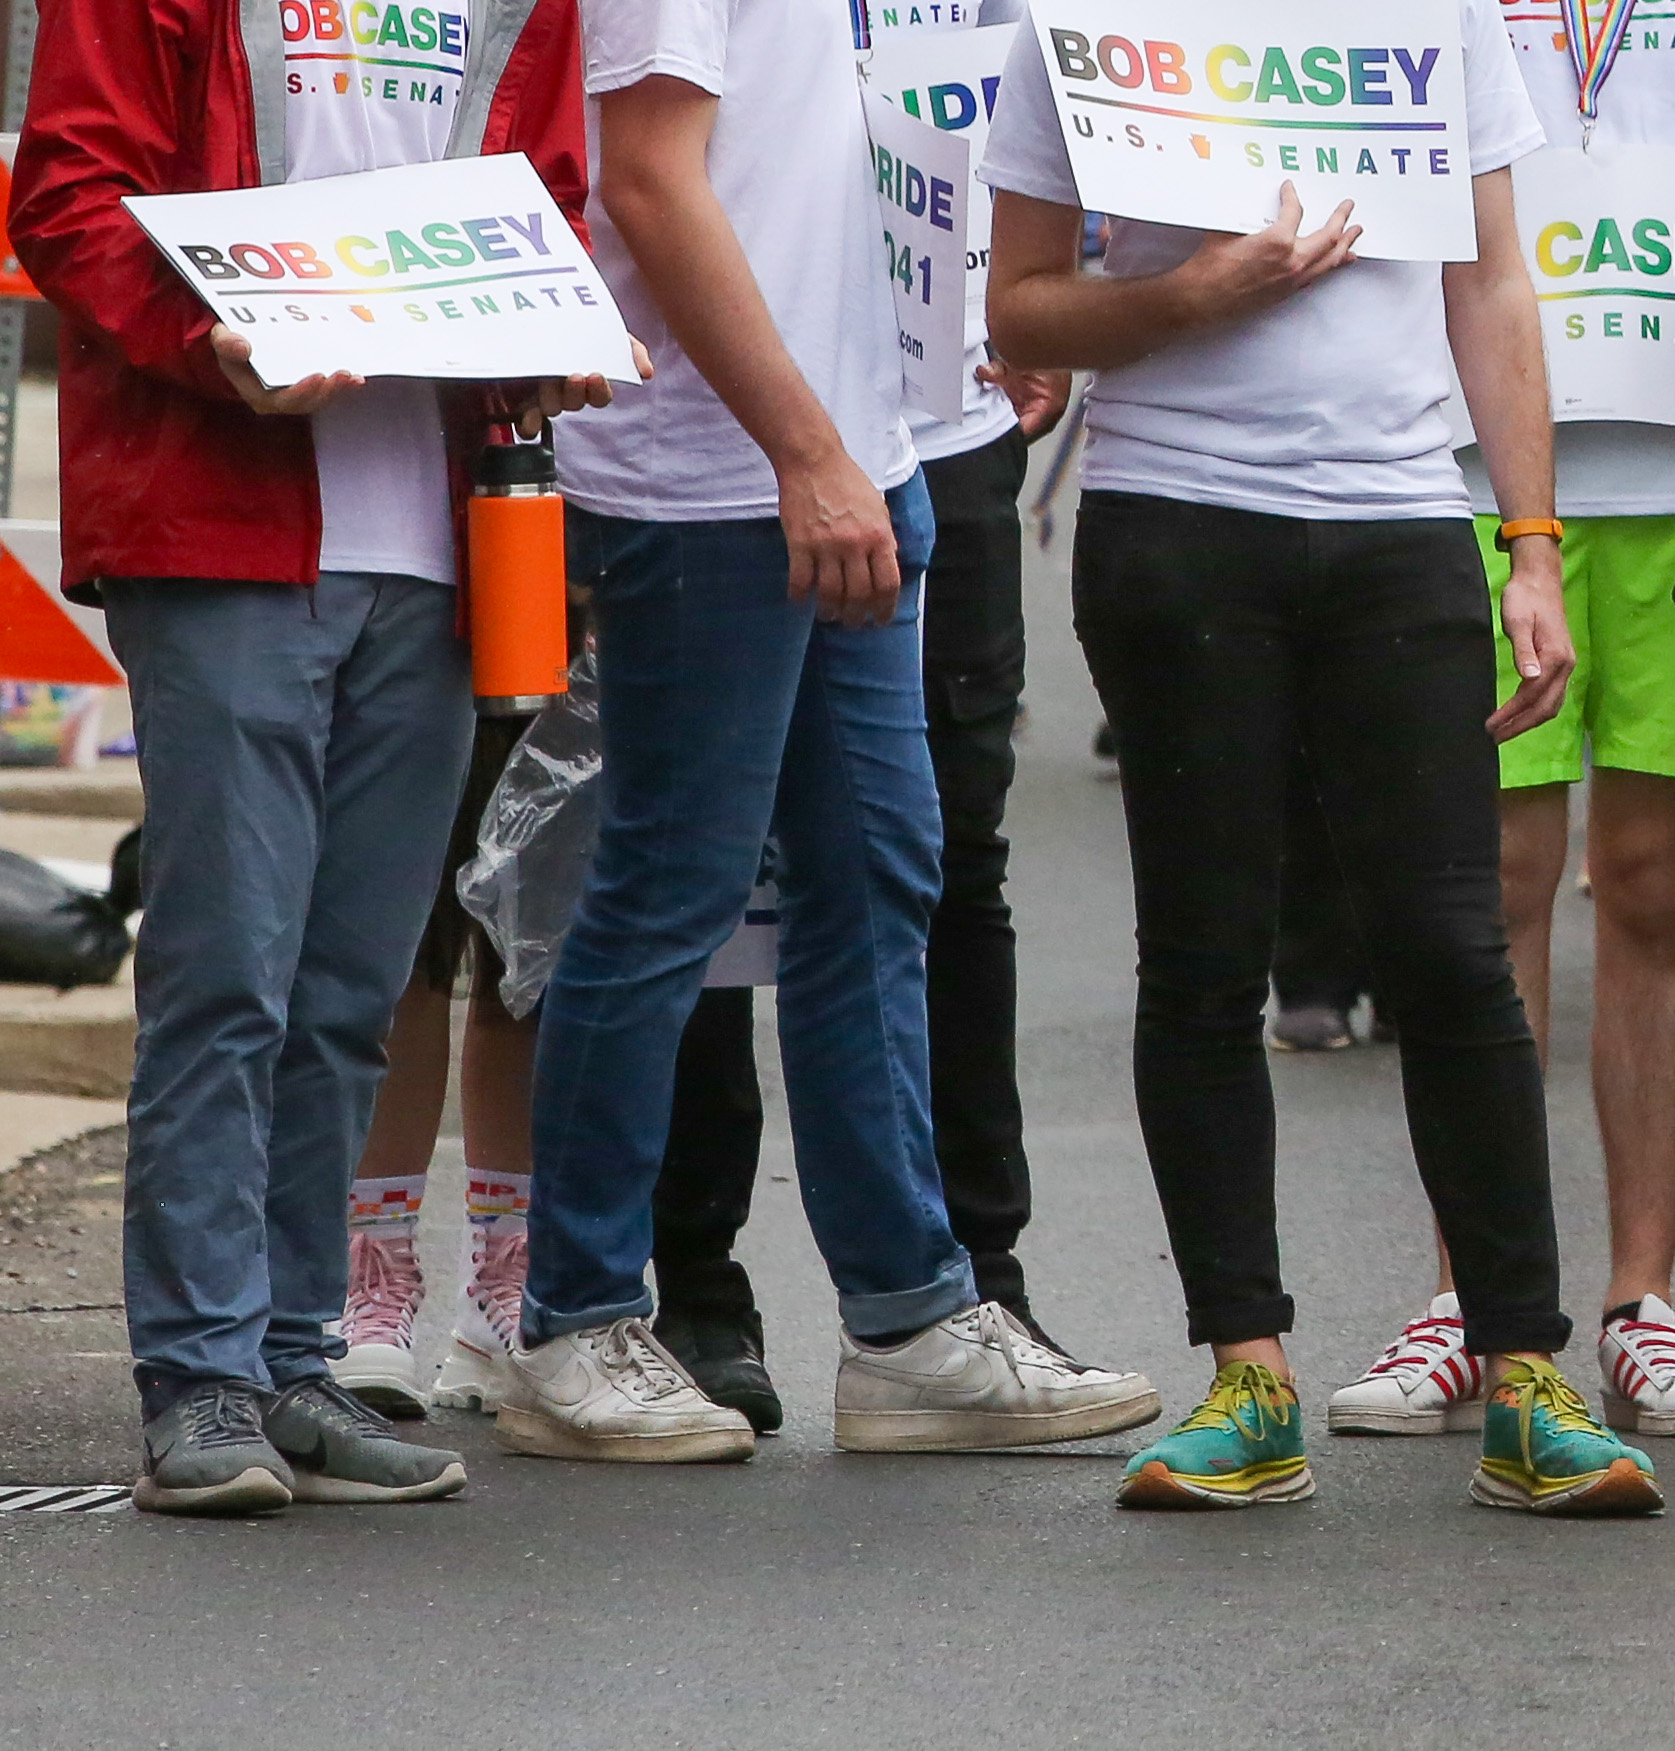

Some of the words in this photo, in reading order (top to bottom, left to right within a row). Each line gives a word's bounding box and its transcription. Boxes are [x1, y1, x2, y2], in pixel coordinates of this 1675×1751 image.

[280, 0, 344, 42] OB
[350, 1, 468, 57] CASE
[286, 72, 317, 95] S.
[360, 76, 460, 105] SENA
[1049, 27, 1192, 95] BOB
[1205, 43, 1441, 107] CASEY
[1071, 114, 1164, 152] U.S.
[1244, 142, 1450, 176] SENATE
[869, 138, 954, 233] RIDE
[178, 242, 333, 280] BOB
[335, 212, 552, 278] CASEY
[229, 304, 330, 323] U.S.
[404, 286, 599, 322] SENATE
